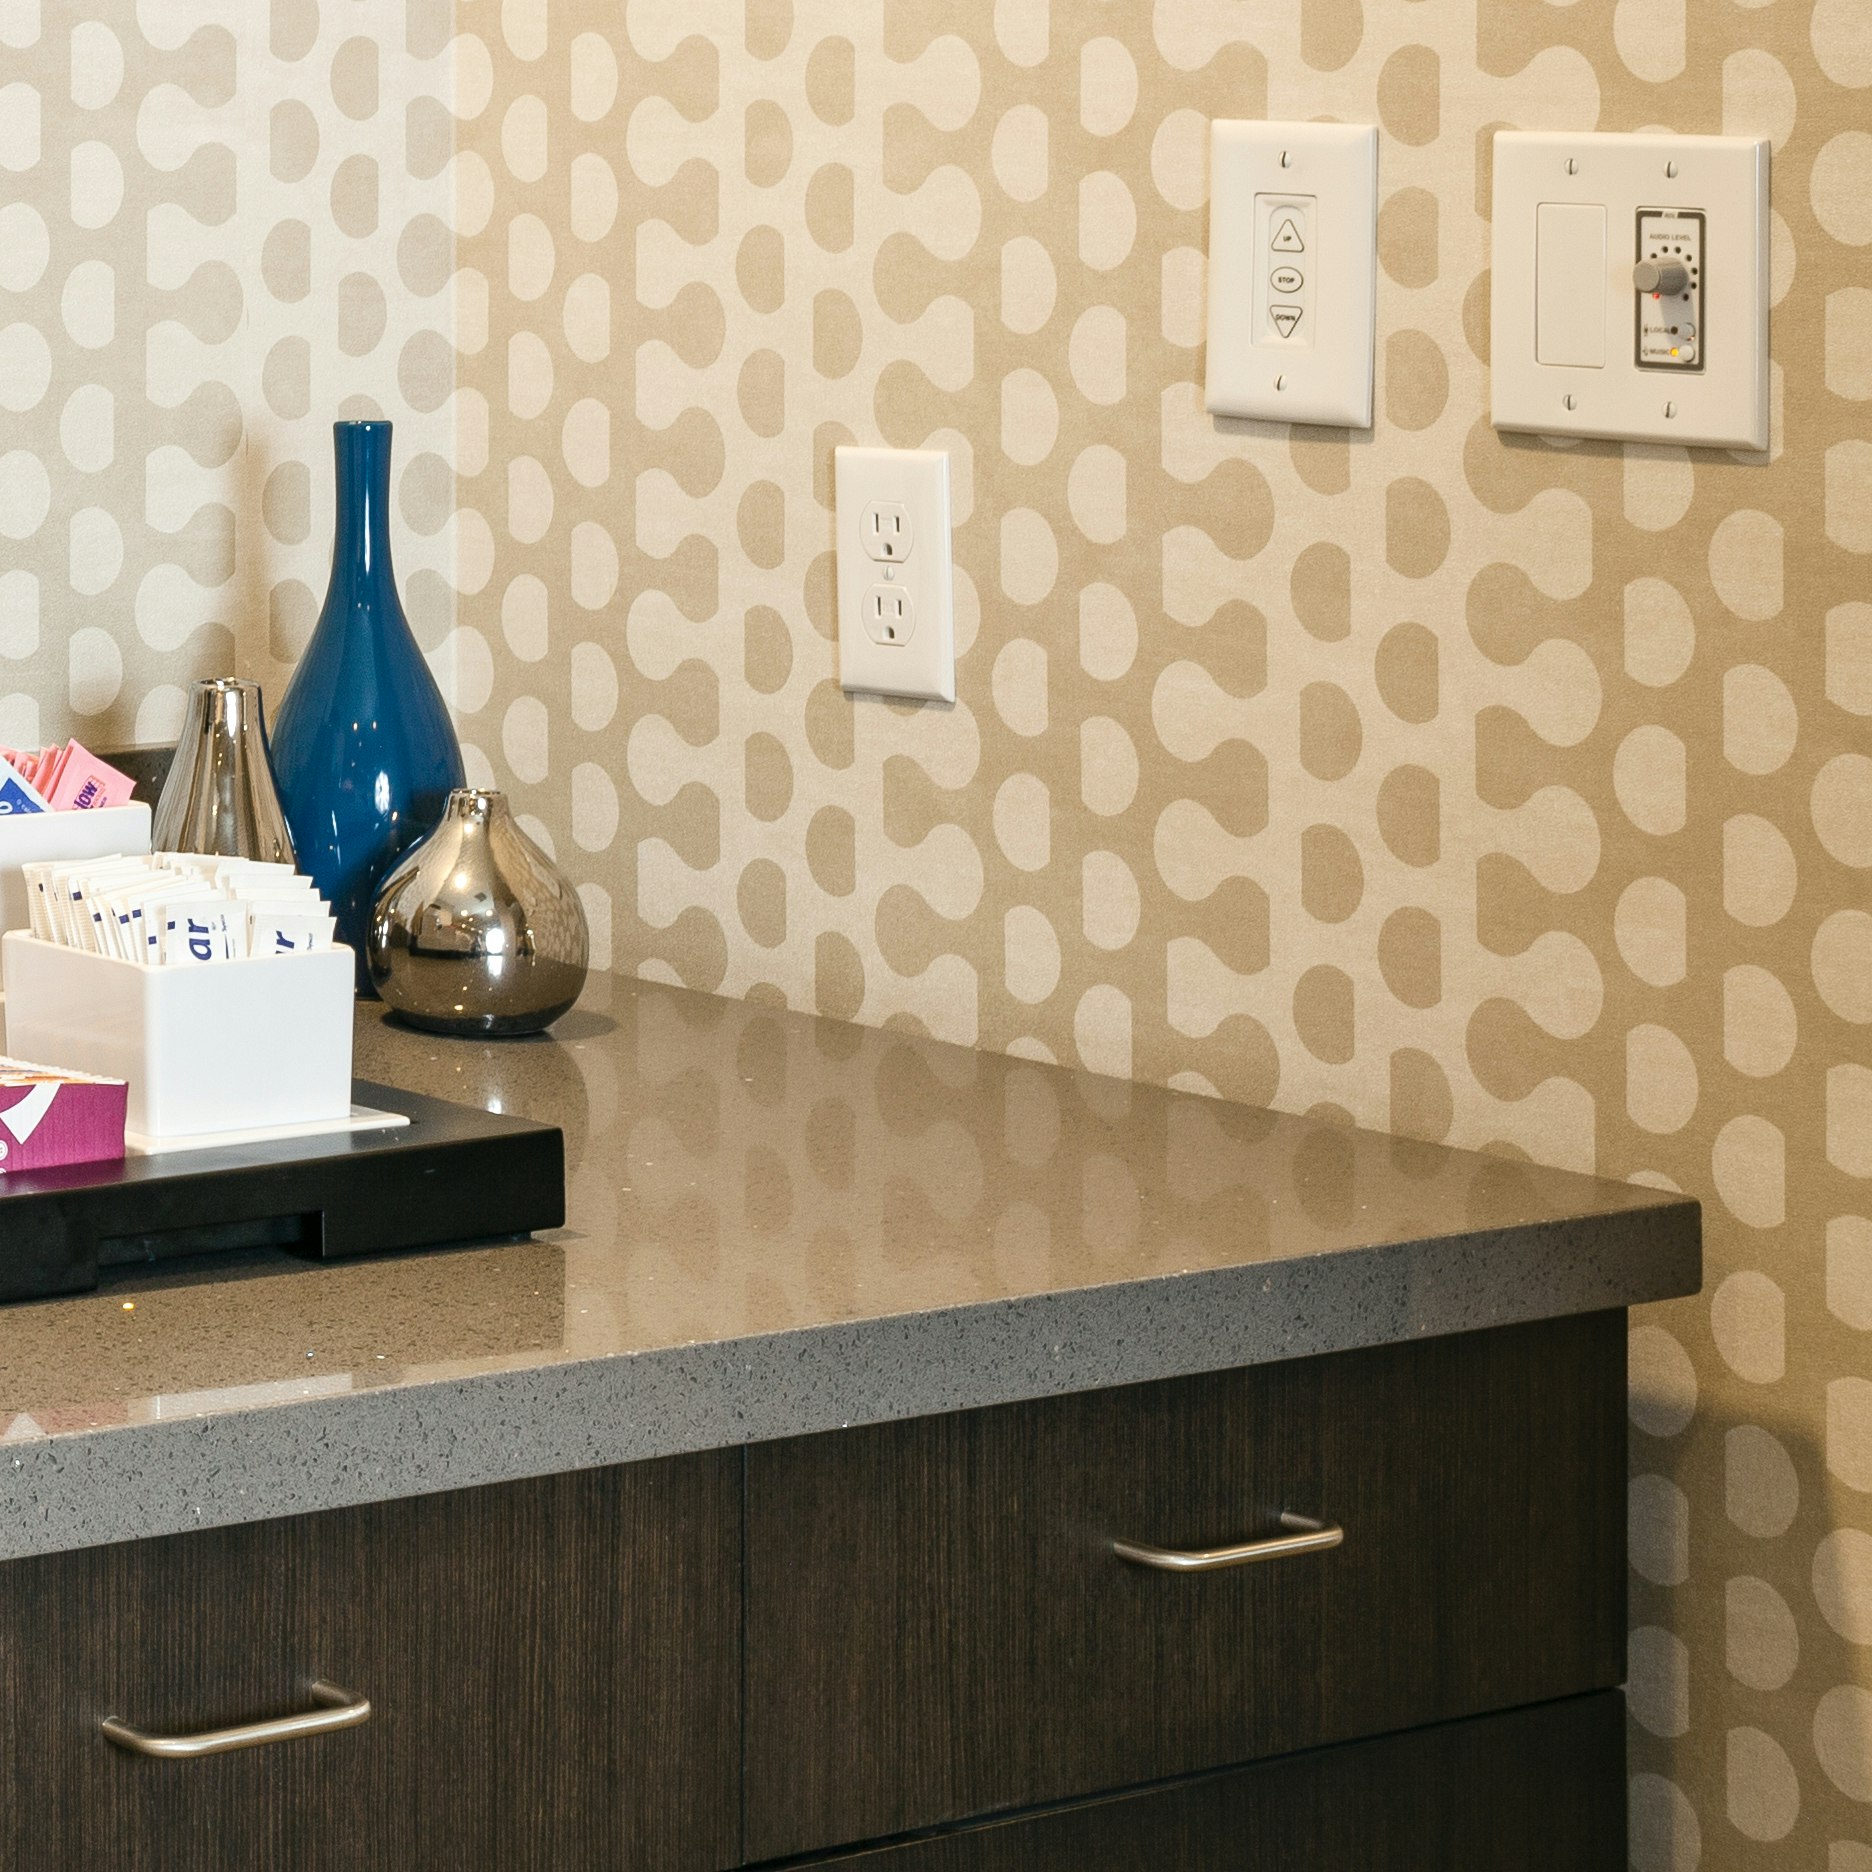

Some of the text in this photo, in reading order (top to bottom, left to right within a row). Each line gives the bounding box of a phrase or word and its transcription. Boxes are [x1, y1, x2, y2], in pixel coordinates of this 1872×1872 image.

[1282, 235, 1293, 243] UP
[1649, 232, 1692, 242] AUDIO LEVEL
[1277, 276, 1296, 284] STOP
[1275, 313, 1297, 322] DOWN
